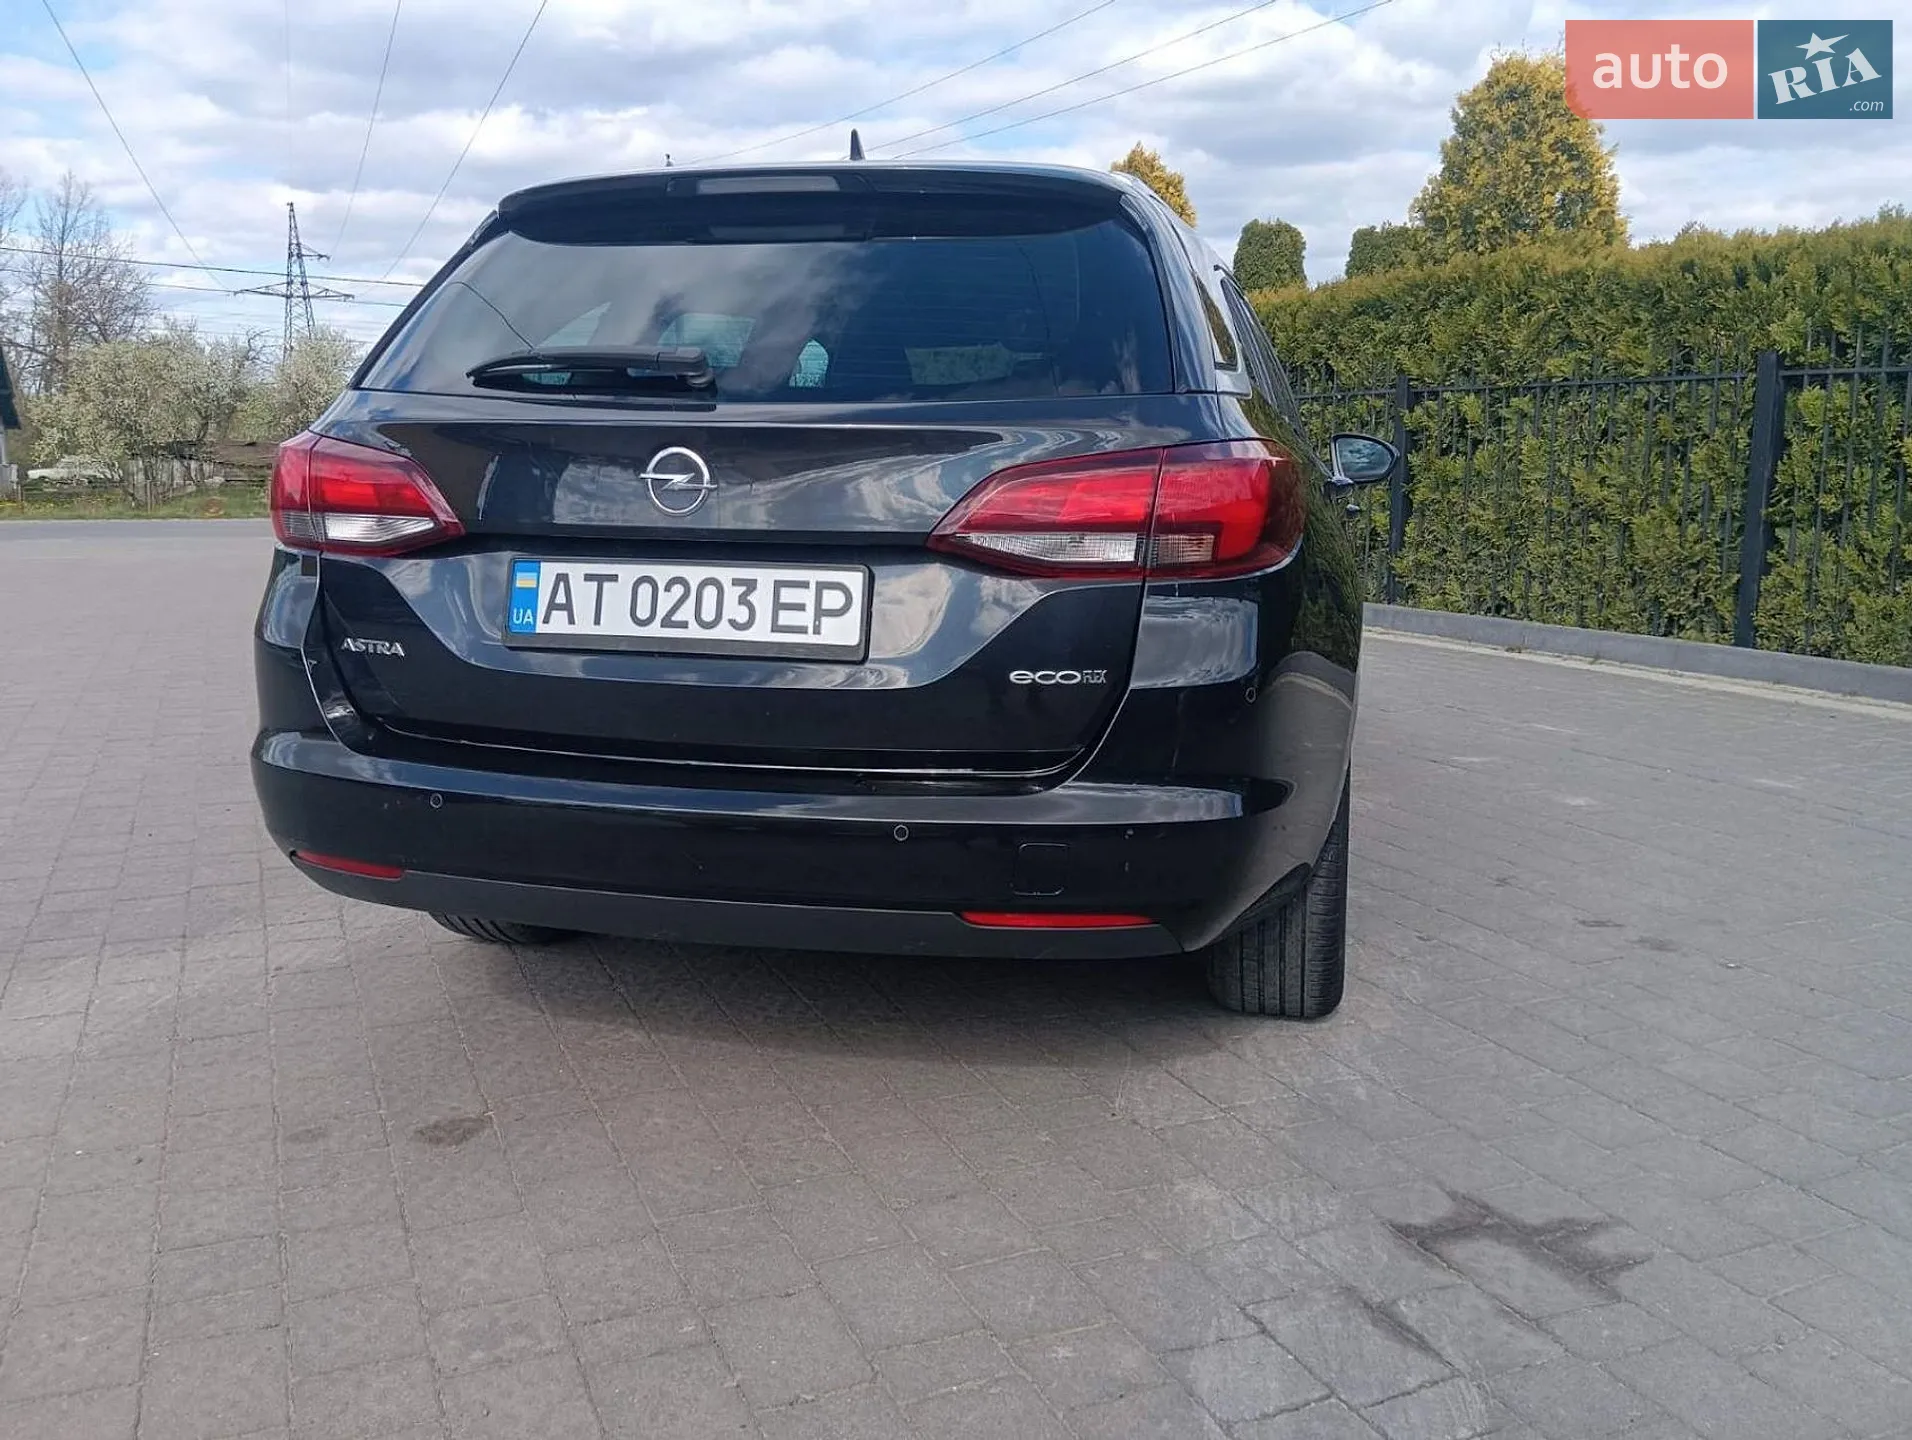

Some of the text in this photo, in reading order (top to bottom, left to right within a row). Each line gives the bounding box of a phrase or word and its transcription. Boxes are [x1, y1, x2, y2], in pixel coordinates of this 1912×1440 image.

[542, 573, 853, 635] AT 0203 EP
[512, 608, 534, 625] UA
[341, 637, 405, 656] ASTRA
